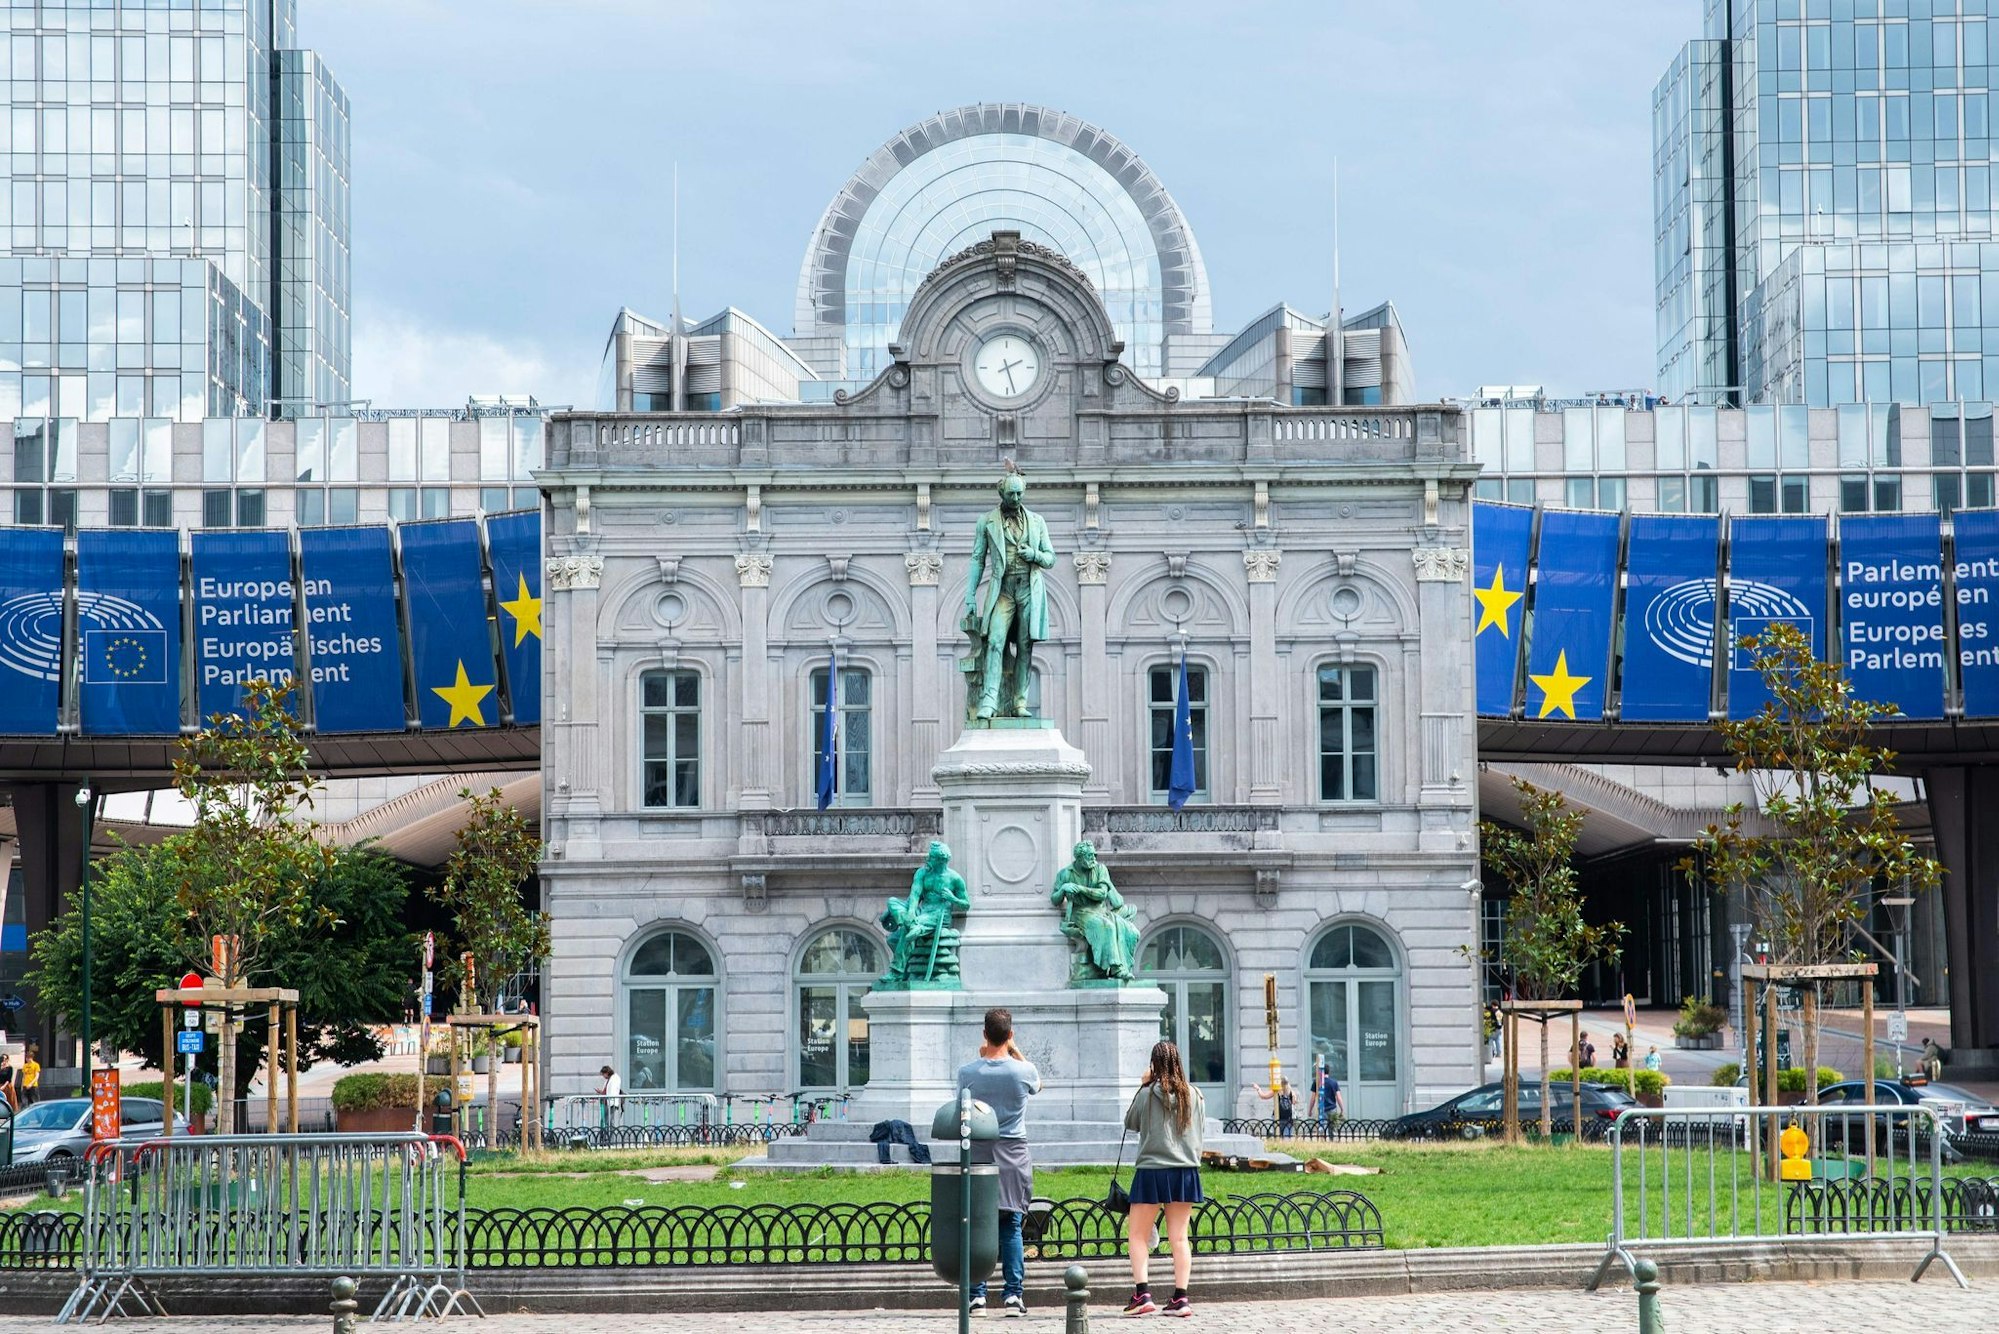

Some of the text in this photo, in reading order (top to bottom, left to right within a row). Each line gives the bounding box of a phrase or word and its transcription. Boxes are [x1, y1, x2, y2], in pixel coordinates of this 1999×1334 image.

[1847, 558, 1999, 583] Parlement
[200, 576, 332, 601] European
[1847, 584, 1989, 612] européen
[201, 602, 352, 626] Parliament
[1849, 621, 1989, 646] Europees
[203, 631, 382, 661] Europäisches
[1850, 646, 1999, 670] Parlement
[204, 662, 350, 686] Parlament
[636, 1047, 659, 1055] Europe
[807, 1044, 830, 1053] Europe
[1365, 1039, 1387, 1048] Europe
